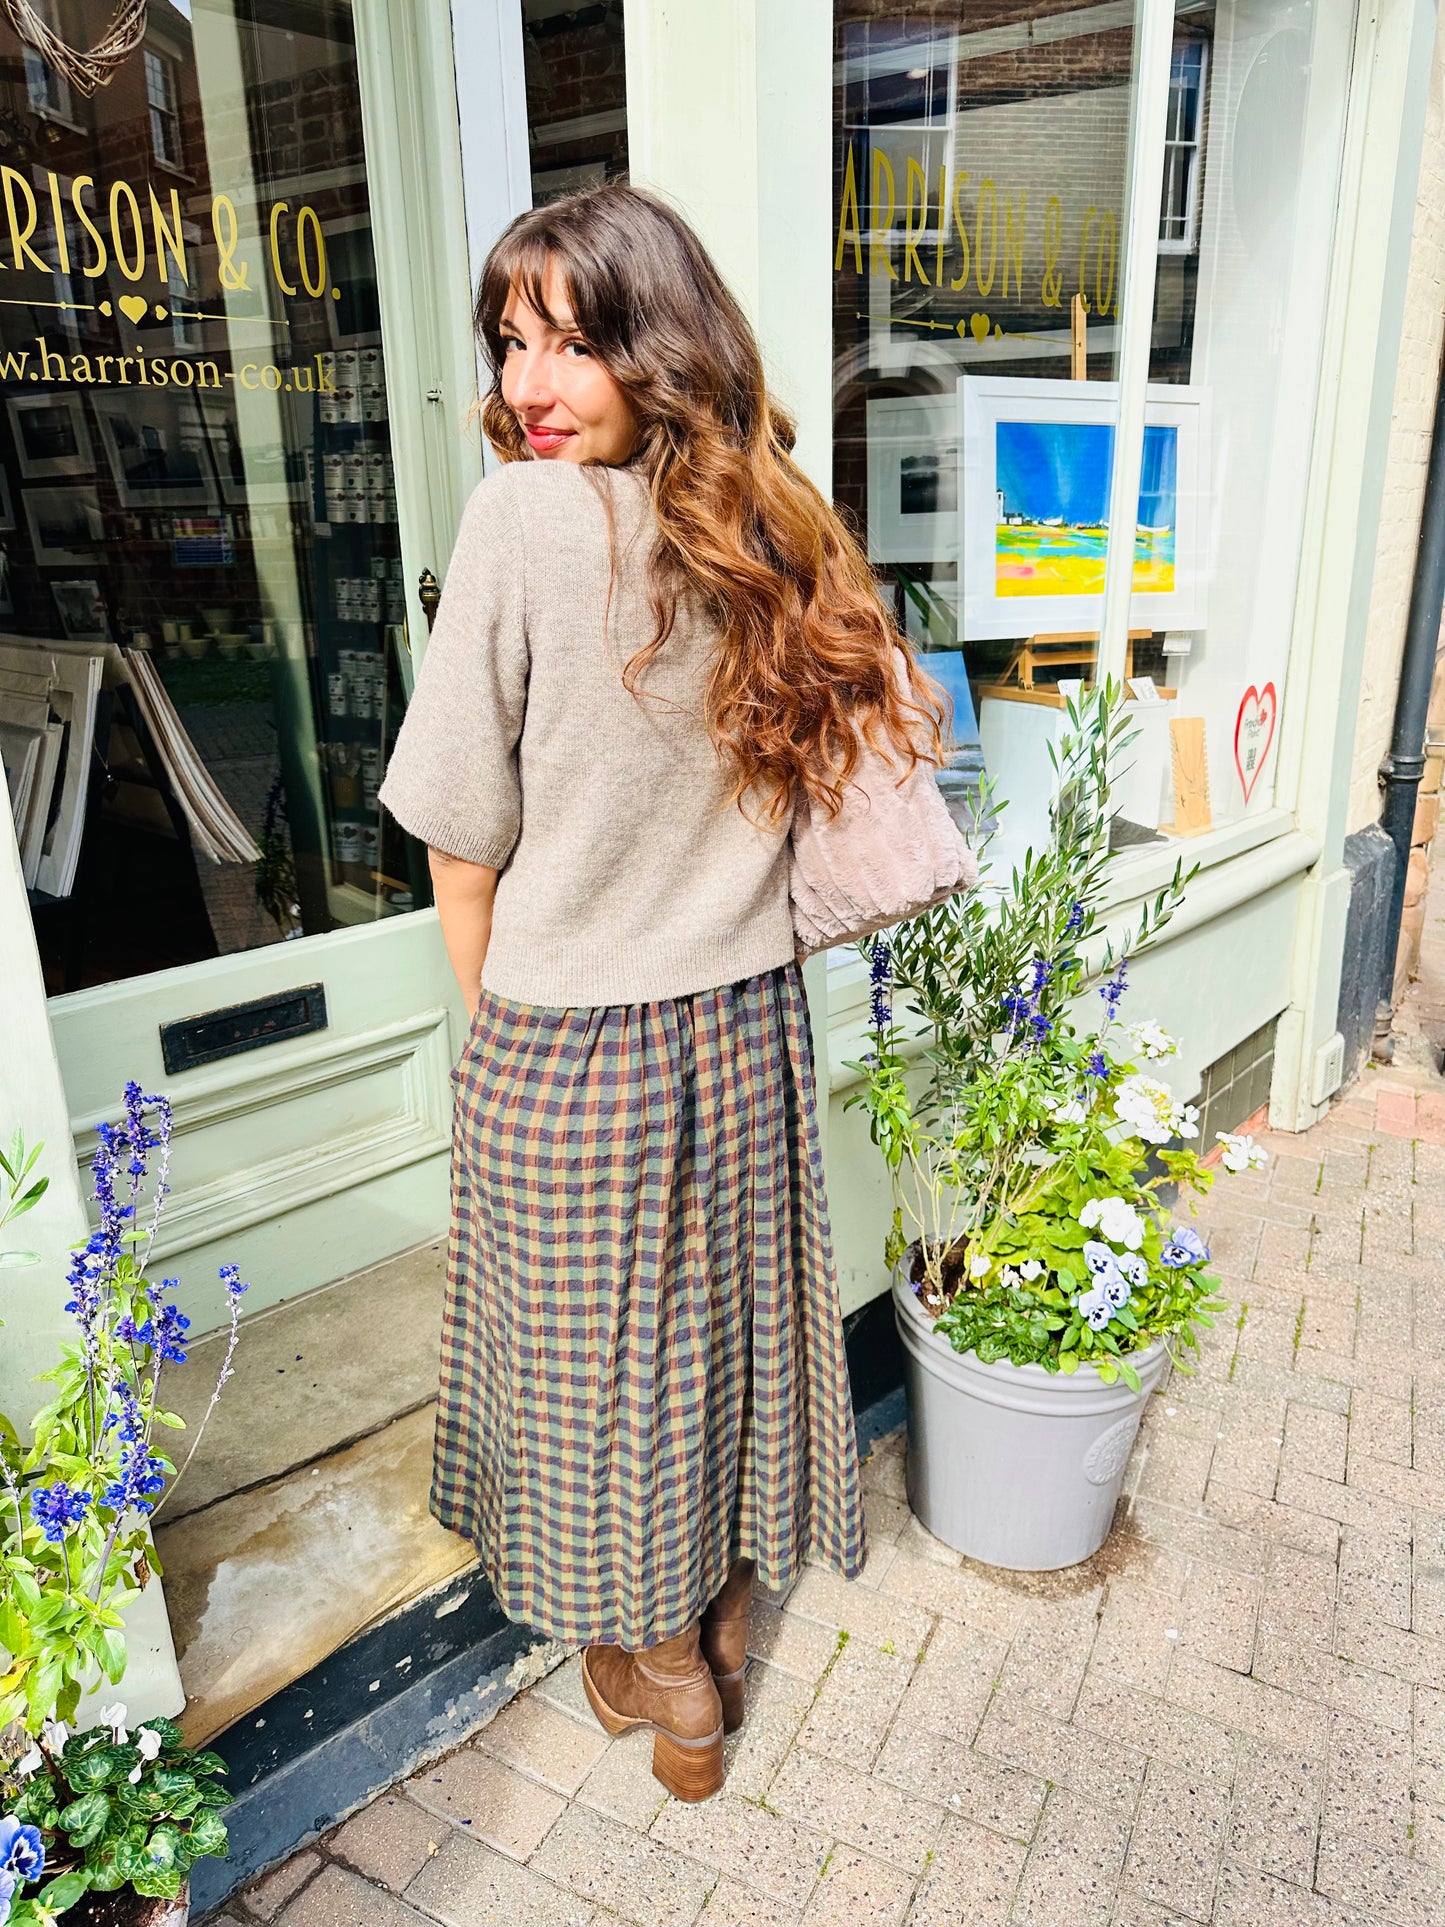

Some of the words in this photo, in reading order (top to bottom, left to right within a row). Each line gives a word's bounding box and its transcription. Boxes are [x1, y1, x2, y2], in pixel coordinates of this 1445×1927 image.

[0, 165, 189, 287] RISON
[212, 195, 252, 291] &
[270, 202, 341, 300] CO.
[1042, 195, 1062, 307] &
